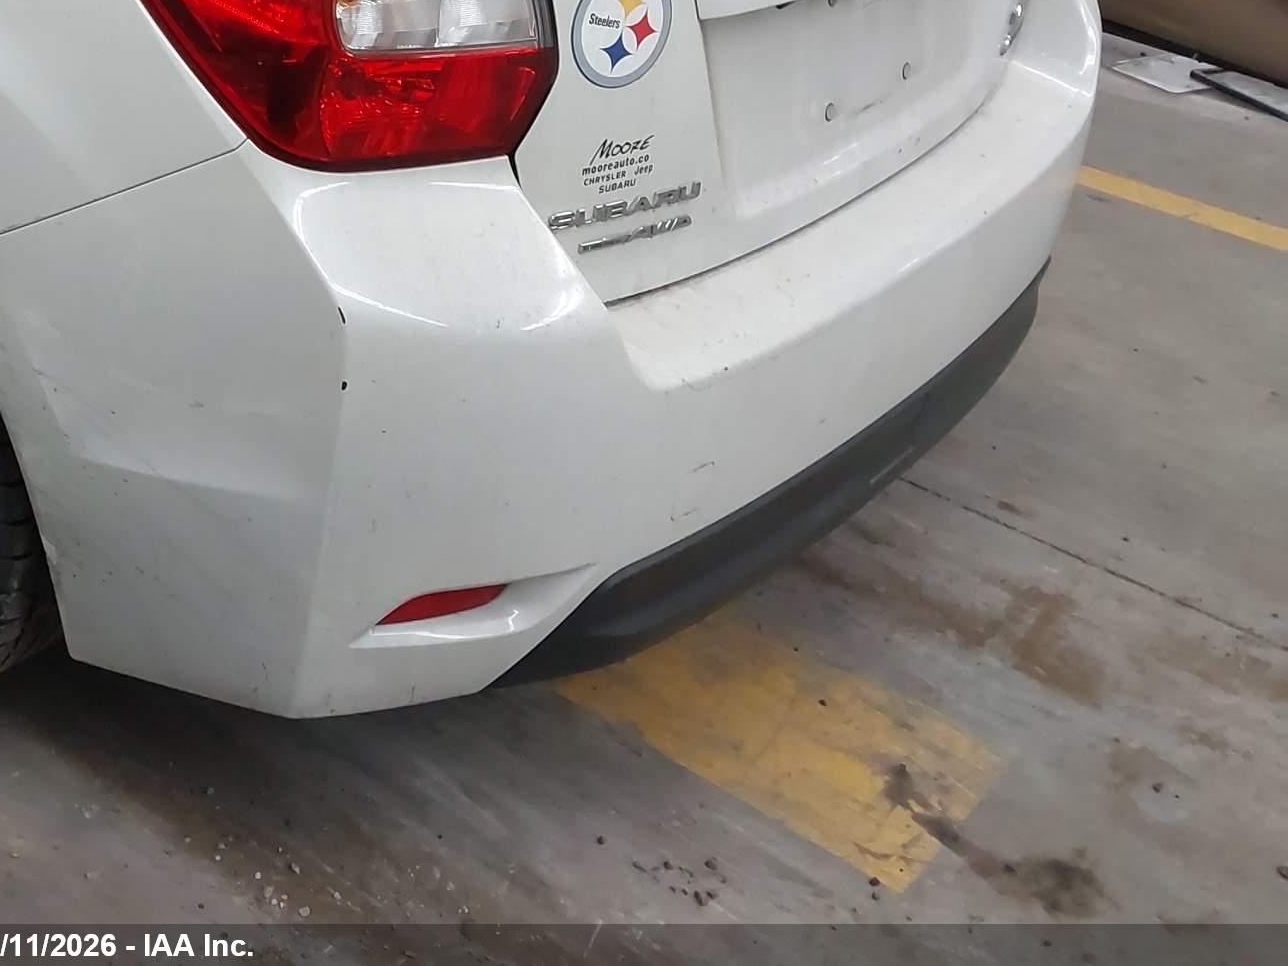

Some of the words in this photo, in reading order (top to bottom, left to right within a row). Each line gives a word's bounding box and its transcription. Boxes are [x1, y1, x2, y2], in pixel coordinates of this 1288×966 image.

[588, 13, 621, 29] Steelers
[581, 153, 650, 176] mooreauto.co
[583, 170, 627, 186] CHRYSLER
[633, 164, 654, 176] Jeep
[598, 179, 637, 194] SUBARU
[548, 181, 702, 231] SUBARU
